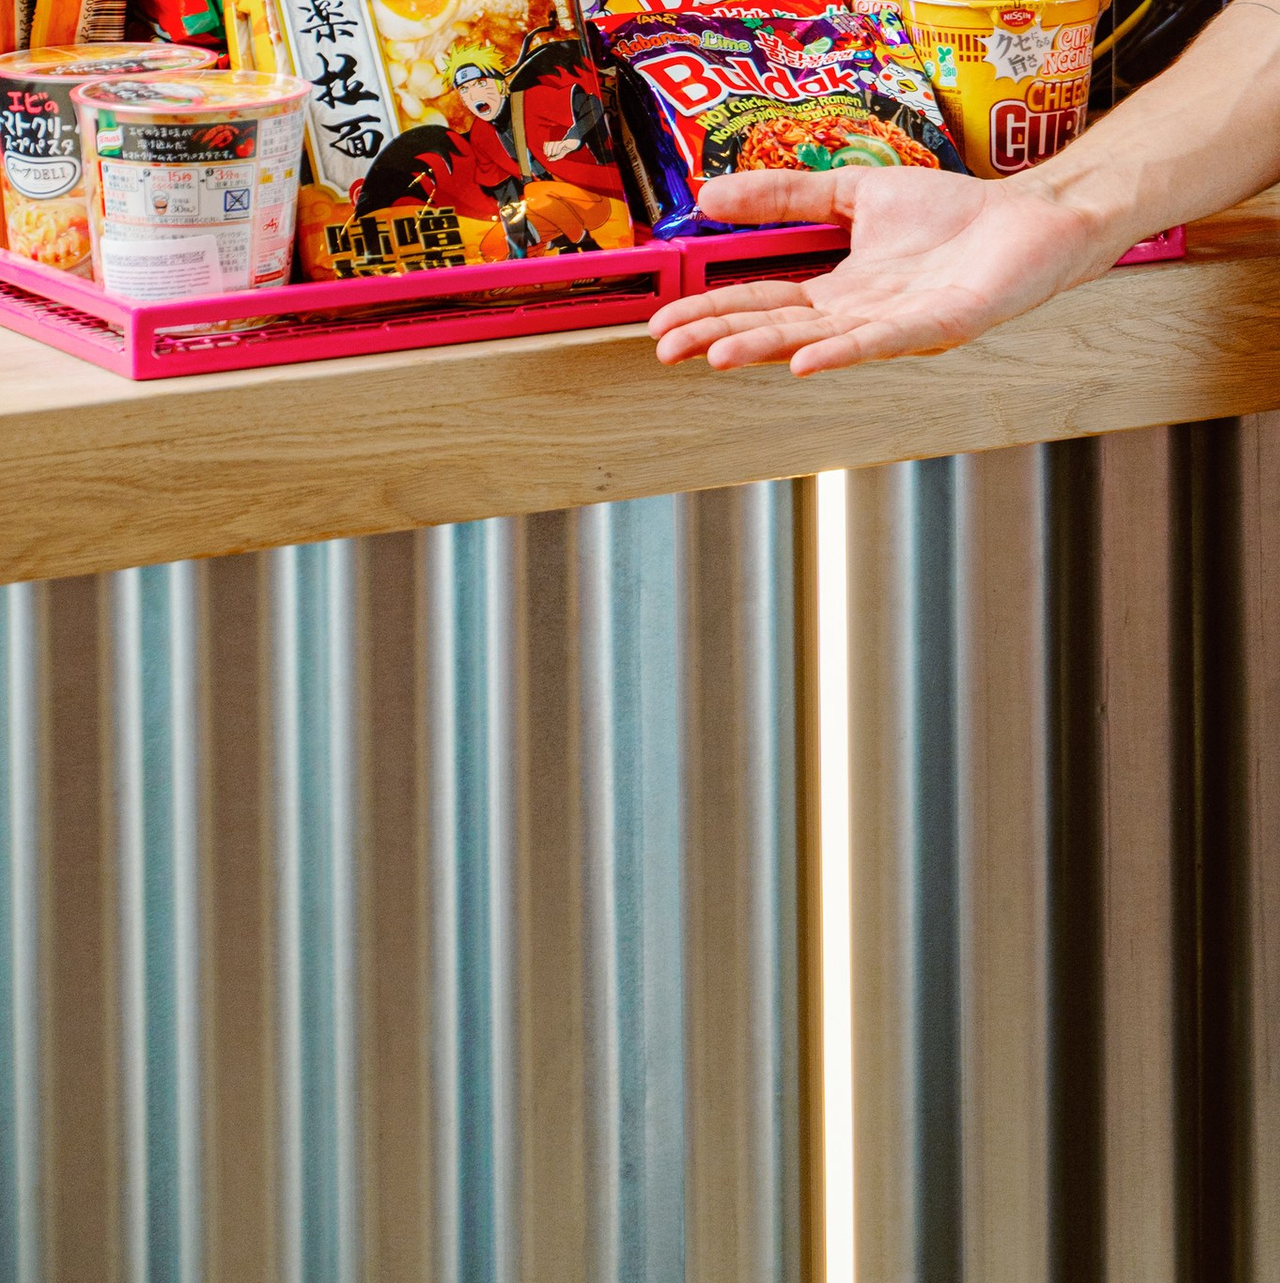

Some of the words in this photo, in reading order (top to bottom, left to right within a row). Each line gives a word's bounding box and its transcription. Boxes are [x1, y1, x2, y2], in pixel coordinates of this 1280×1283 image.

[1003, 11, 1031, 21] NISSIN
[701, 30, 751, 53] Lime
[637, 51, 858, 115] Buldak
[7, 90, 60, 115] エビの
[695, 103, 731, 131] HOT
[818, 95, 862, 108] Ramen
[0, 109, 82, 140] マトクリー
[991, 99, 1088, 172] CUR
